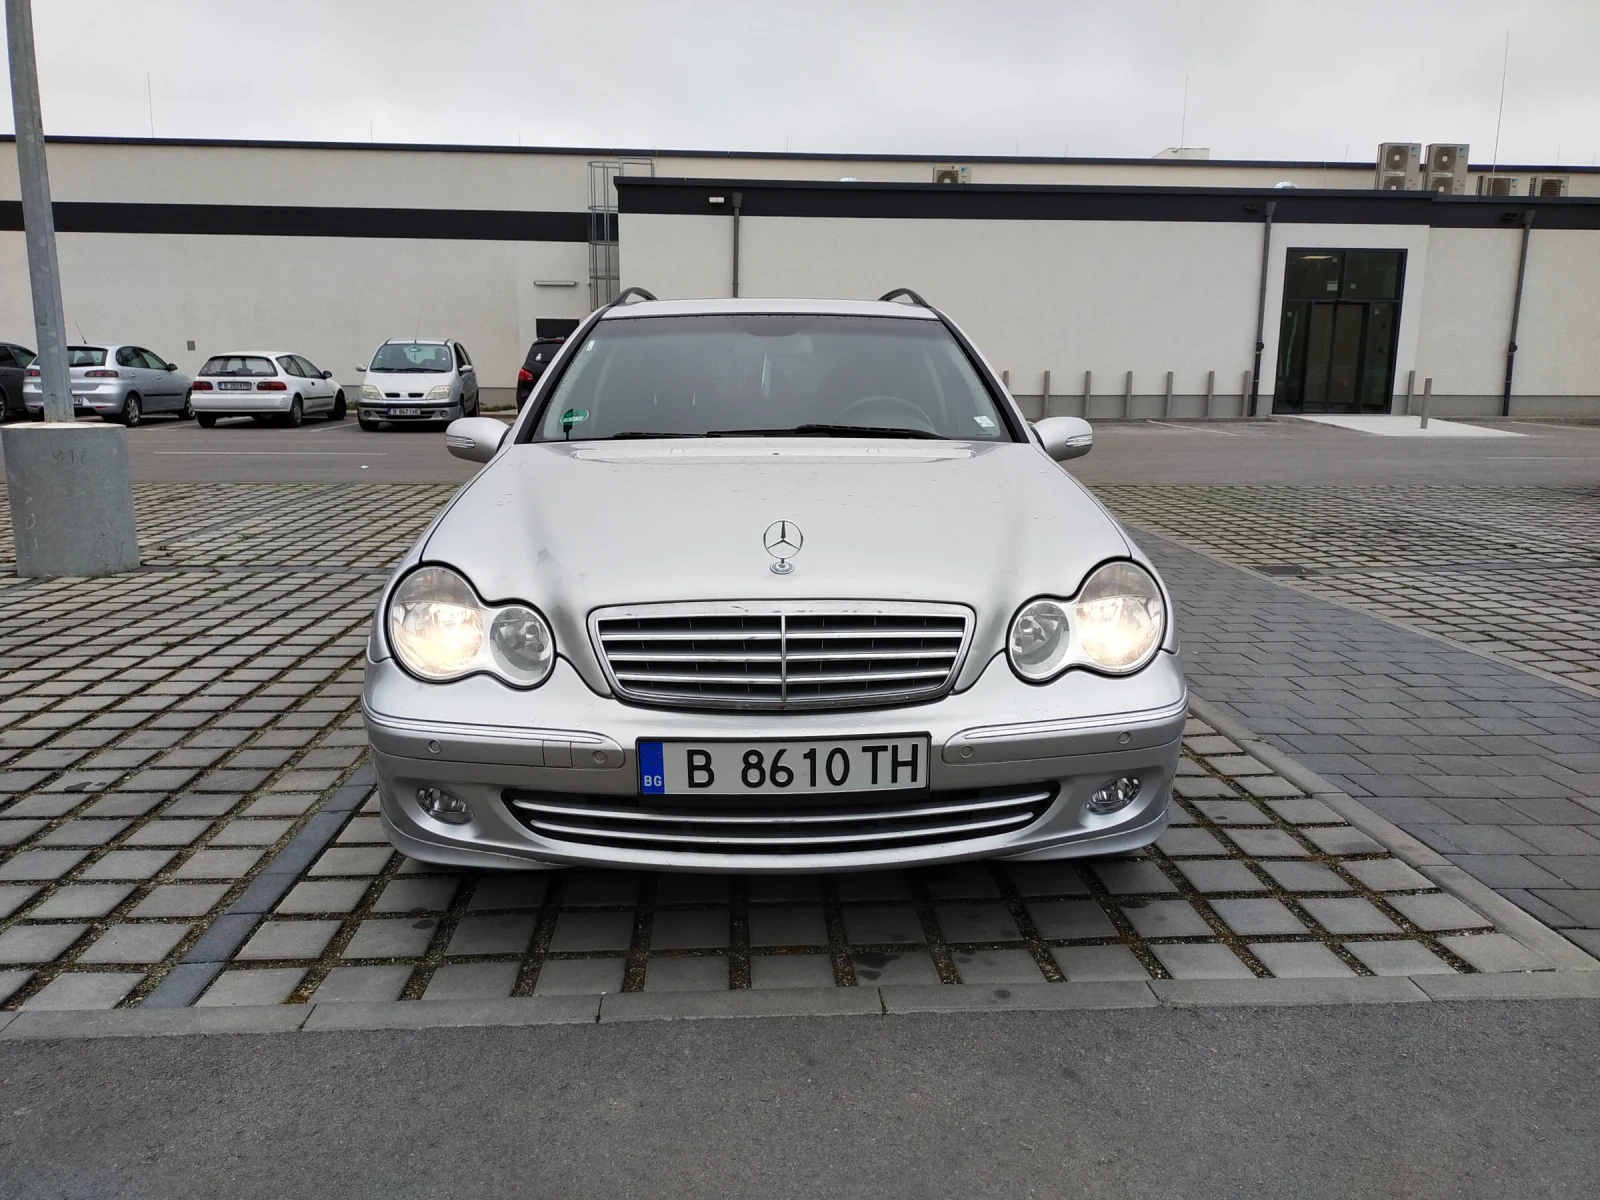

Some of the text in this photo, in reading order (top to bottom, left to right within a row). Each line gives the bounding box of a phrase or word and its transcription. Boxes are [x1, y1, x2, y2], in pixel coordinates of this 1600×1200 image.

[687, 744, 919, 788] B 8610 TH
[643, 775, 662, 787] BG
